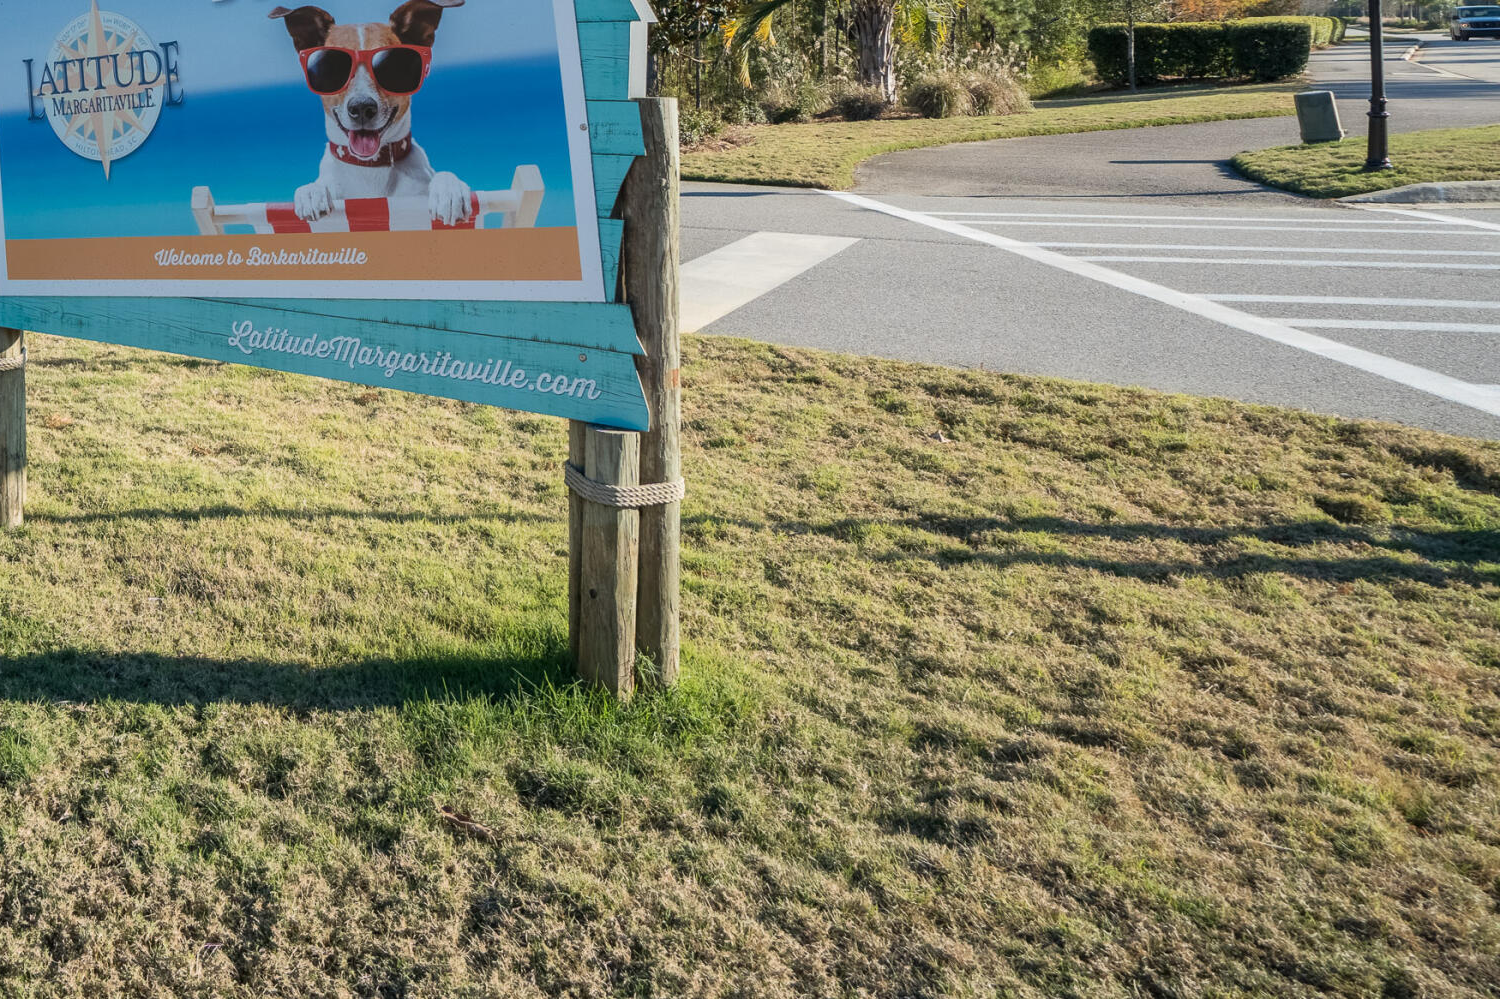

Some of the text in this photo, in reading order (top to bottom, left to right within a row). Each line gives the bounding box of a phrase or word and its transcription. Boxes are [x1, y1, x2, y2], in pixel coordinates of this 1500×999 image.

[22, 40, 184, 121] LATITUDE
[52, 87, 156, 117] MARGARITAVILLE
[154, 246, 369, 267] Welcome to Barkaritaville
[227, 319, 602, 400] LatitudeMargaritaville.com
